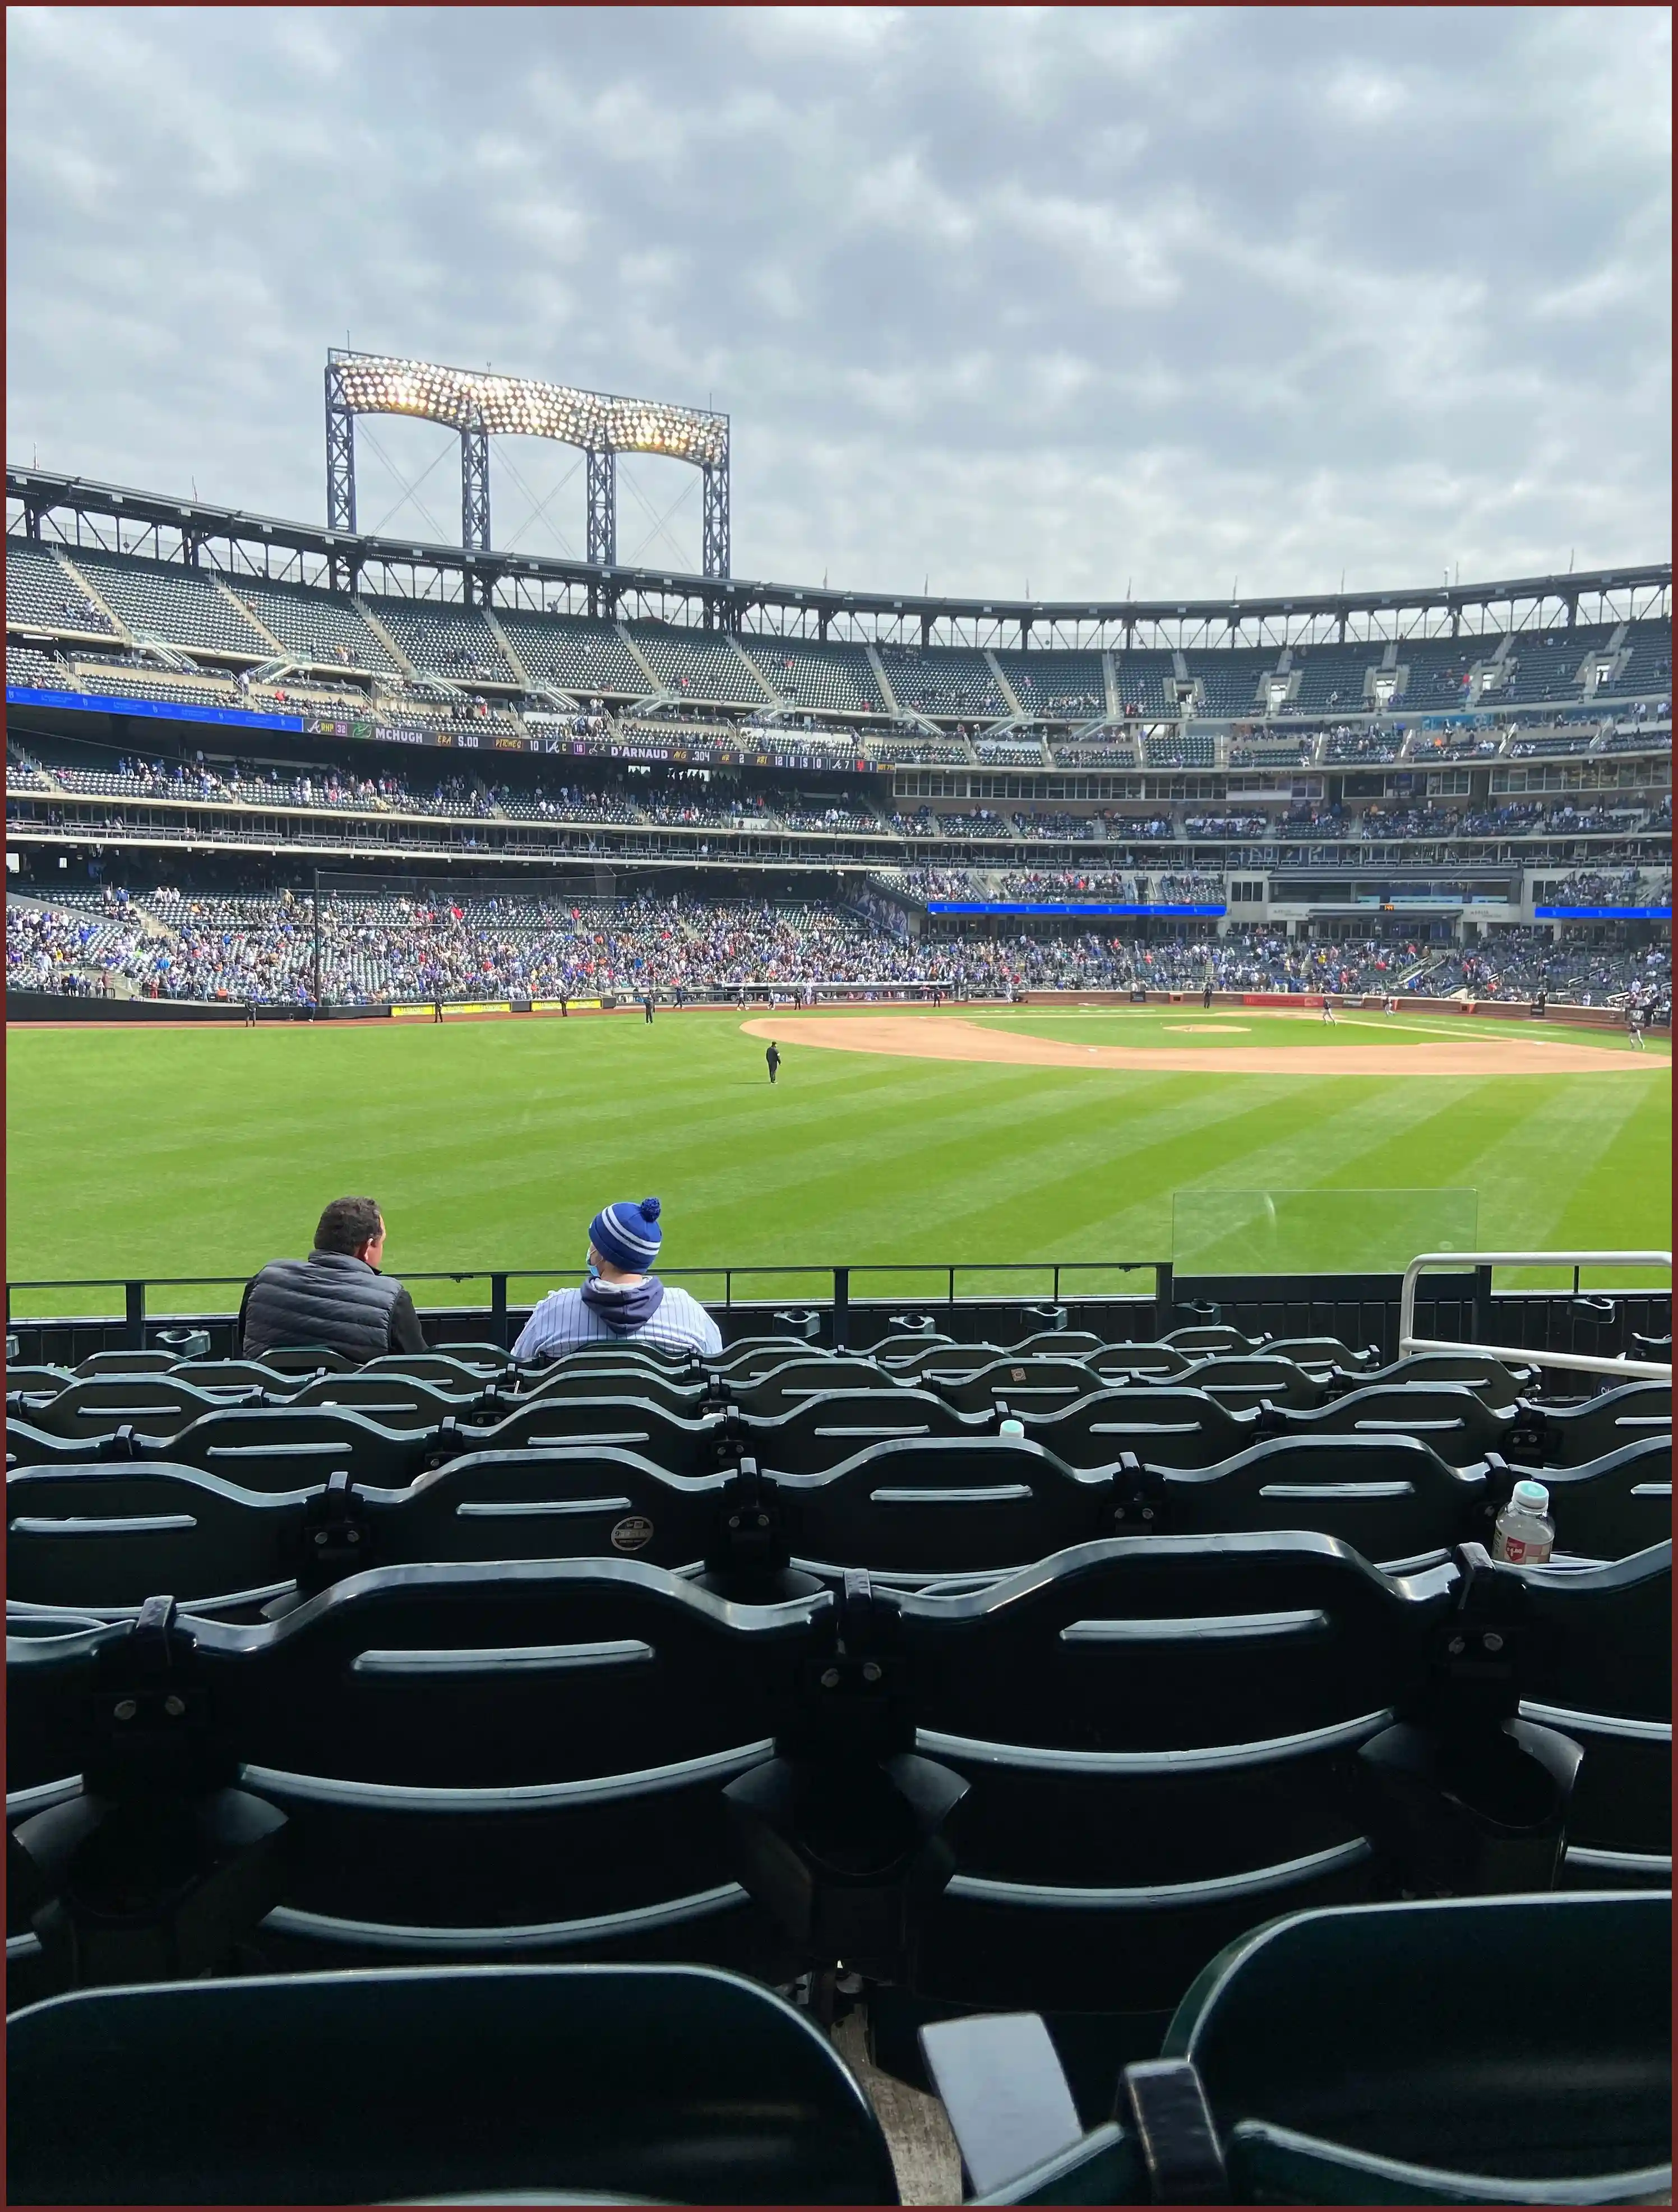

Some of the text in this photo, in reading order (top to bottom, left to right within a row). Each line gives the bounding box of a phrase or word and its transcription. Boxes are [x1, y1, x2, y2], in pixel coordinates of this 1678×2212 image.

[321, 723, 334, 733] RHP
[337, 724, 346, 734] 32
[437, 735, 452, 744] ERA
[458, 735, 478, 747] 5.00
[495, 738, 522, 749] PITCHES
[530, 740, 539, 751] 10
[562, 743, 567, 752] C
[611, 746, 668, 759] D'ARNAUD
[691, 751, 710, 762] .304
[739, 753, 745, 763] 2
[756, 755, 768, 764] RBI
[775, 756, 783, 766] 12
[803, 757, 808, 767] S
[845, 760, 849, 769] 7
